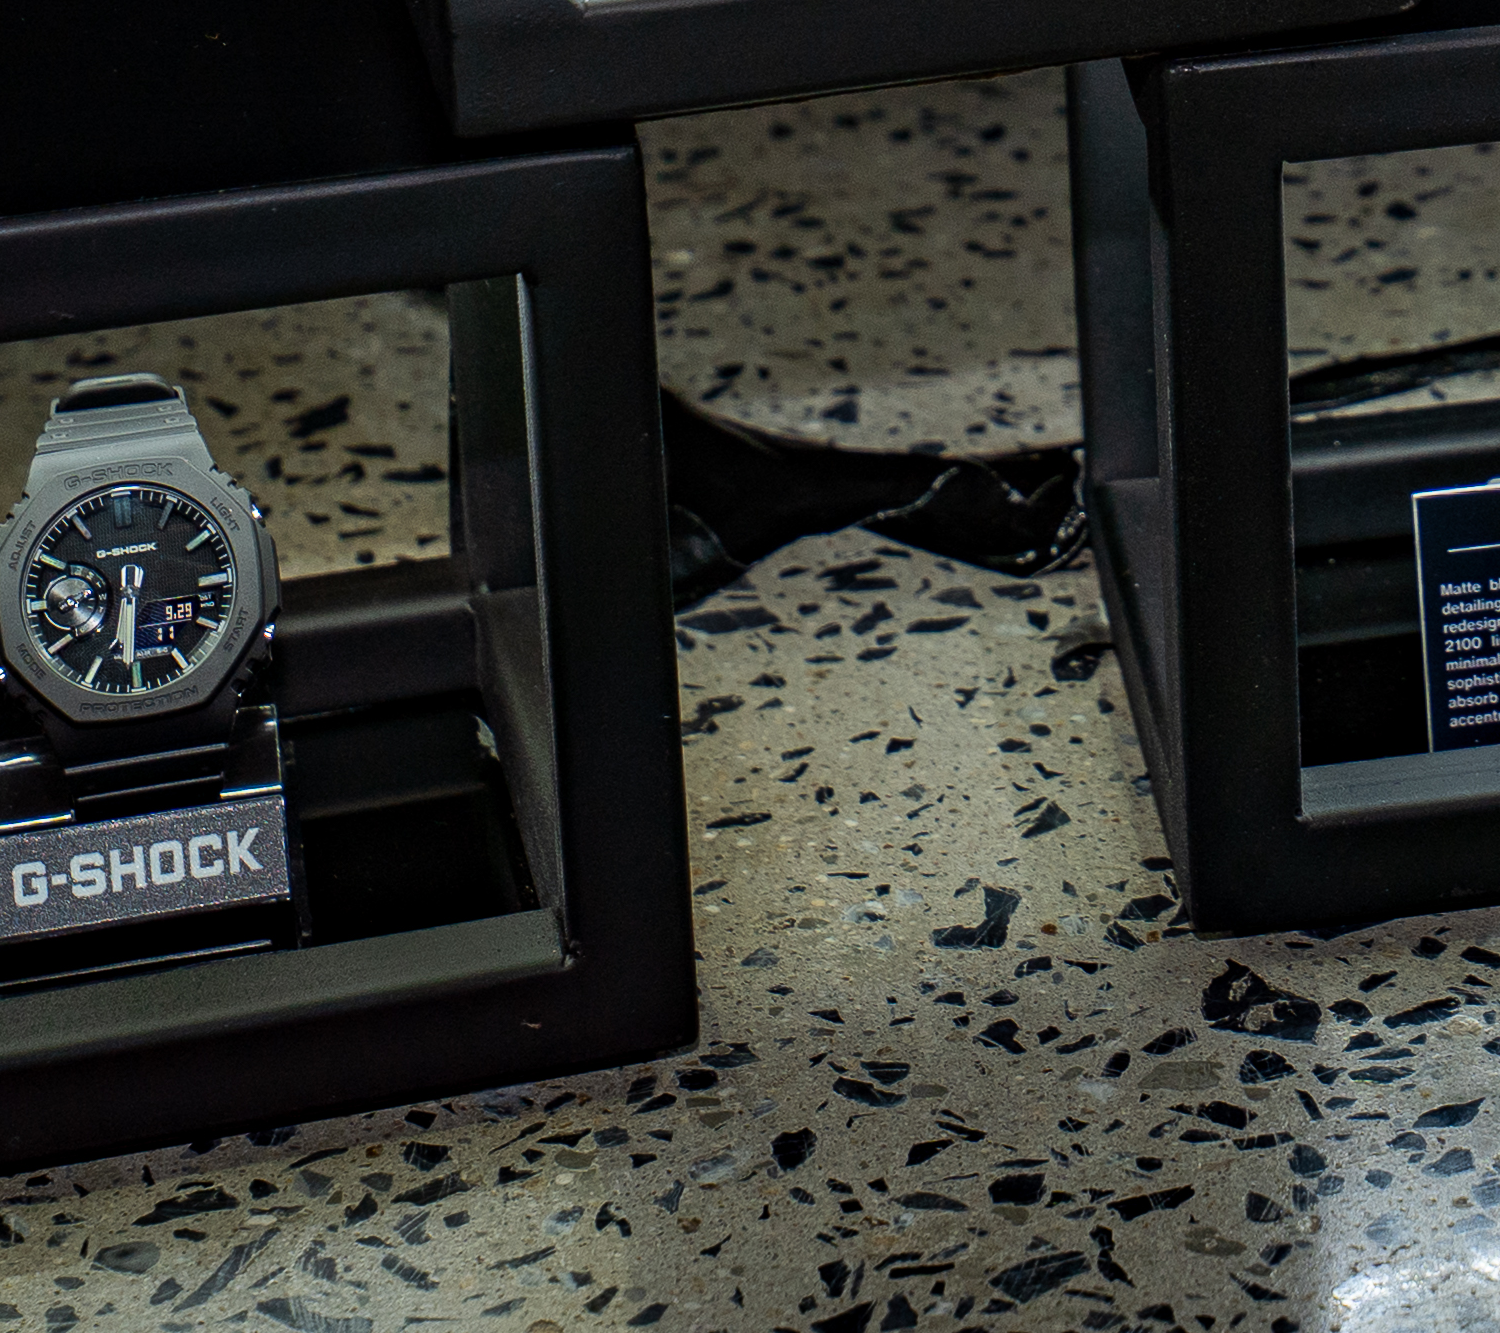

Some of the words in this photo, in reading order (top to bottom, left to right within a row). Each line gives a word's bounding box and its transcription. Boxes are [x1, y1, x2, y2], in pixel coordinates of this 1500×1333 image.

[63, 462, 173, 491] G-SHOCK
[209, 496, 241, 533] LIGHT
[7, 520, 36, 570] ADJUST
[95, 541, 158, 559] G-SHOCK
[1439, 582, 1482, 597] Matte
[165, 602, 192, 621] 9.29
[222, 606, 250, 652] START
[1444, 636, 1483, 653] 2100
[15, 642, 46, 680] MODE
[79, 685, 199, 713] PROTECTION
[1447, 691, 1499, 709] absorb
[11, 827, 264, 908] G-SHOCK
